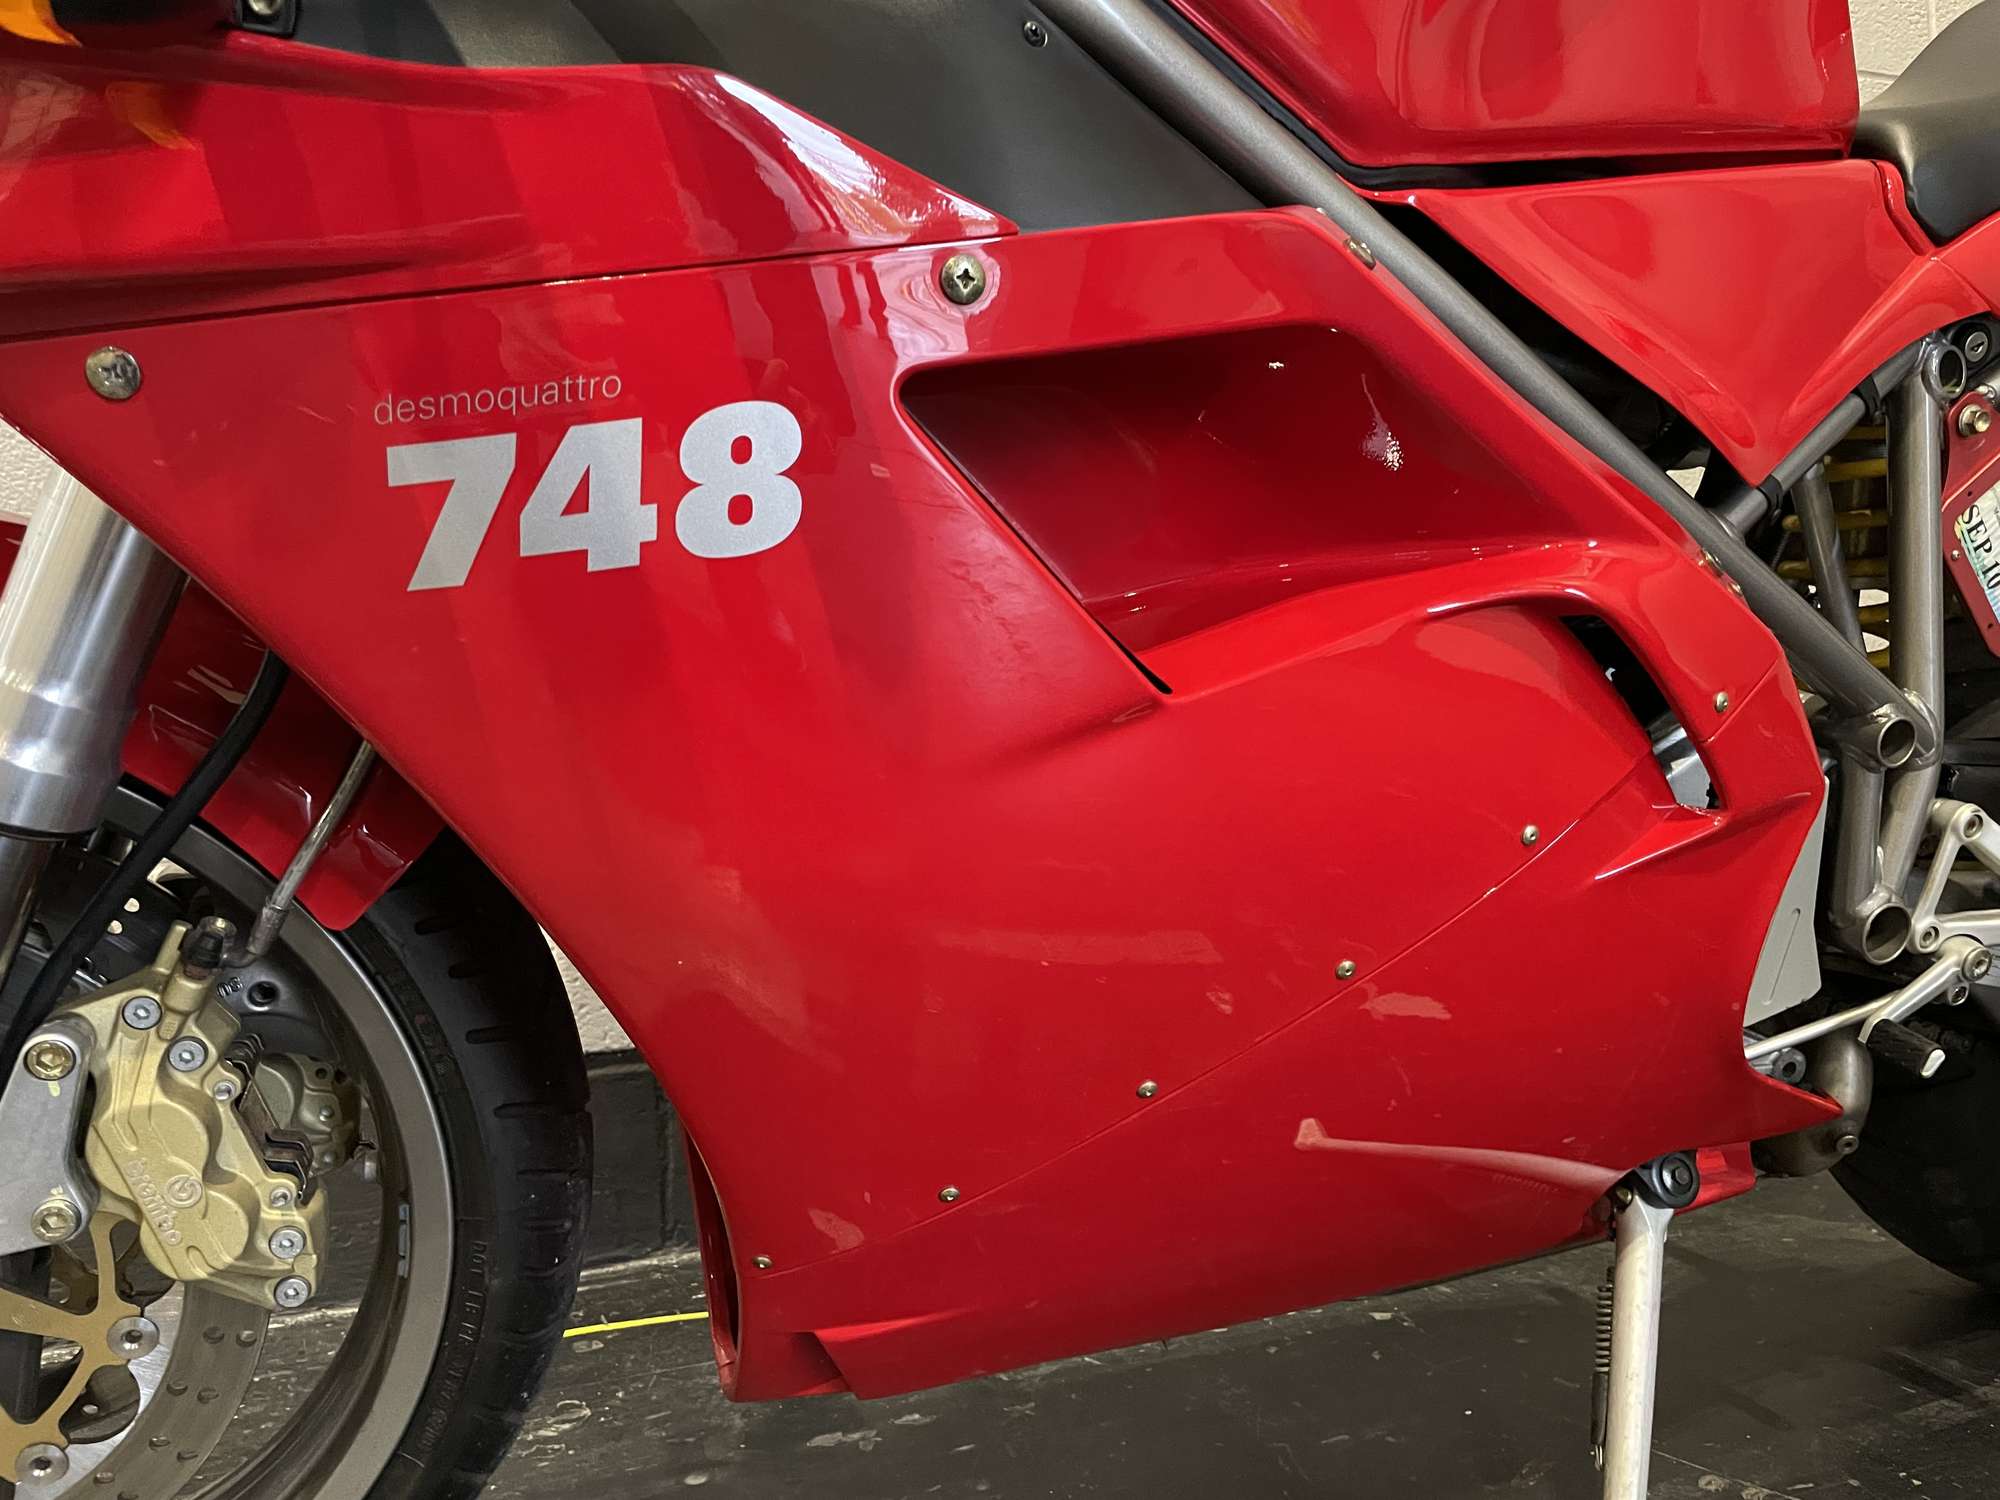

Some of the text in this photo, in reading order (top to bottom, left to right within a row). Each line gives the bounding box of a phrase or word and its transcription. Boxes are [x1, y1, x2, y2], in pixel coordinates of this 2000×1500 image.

[374, 373, 622, 425] desmoquattro
[386, 400, 803, 592] 748
[1962, 505, 1993, 553] SEP
